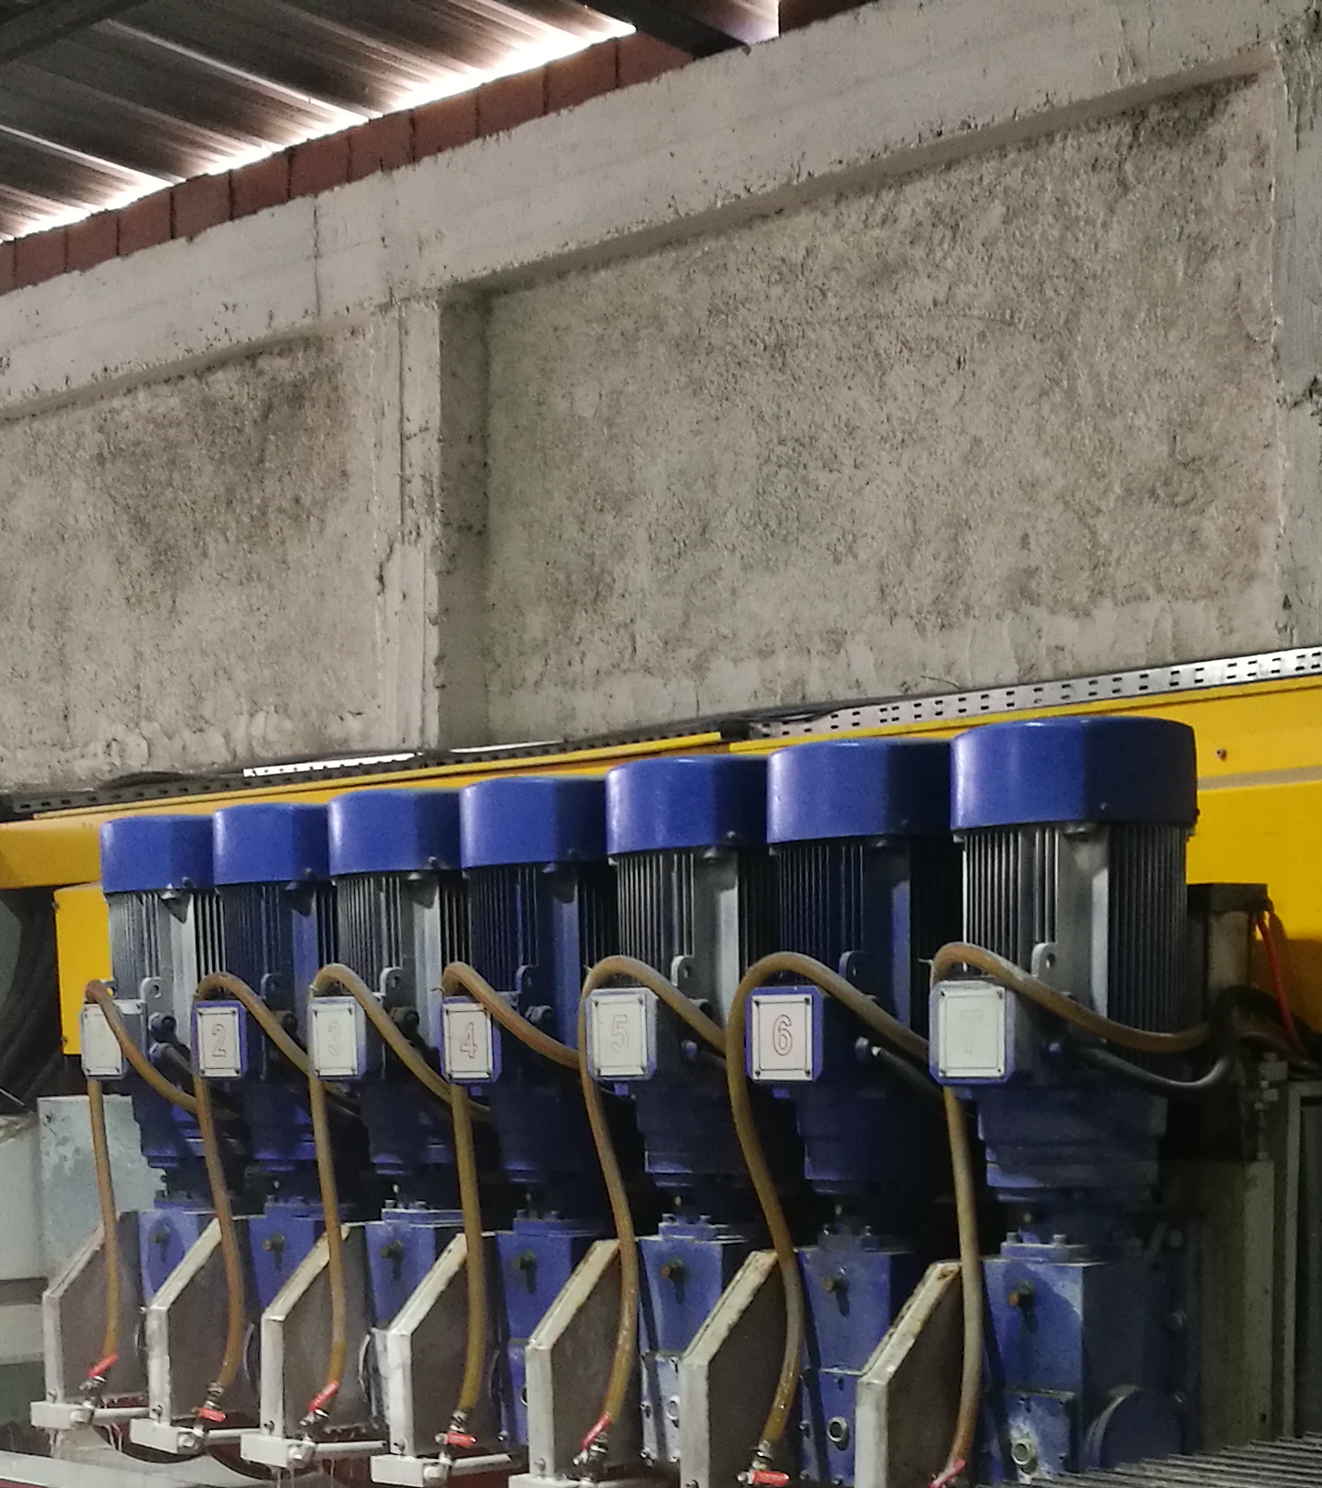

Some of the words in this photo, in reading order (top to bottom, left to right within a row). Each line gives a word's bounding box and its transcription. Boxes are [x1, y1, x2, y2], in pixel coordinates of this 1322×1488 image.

[210, 1023, 227, 1058] 2
[327, 1019, 343, 1057] 3
[459, 1021, 477, 1059] 4
[611, 1014, 630, 1054] 5
[772, 1013, 793, 1057] 6
[960, 1009, 982, 1054] 7
